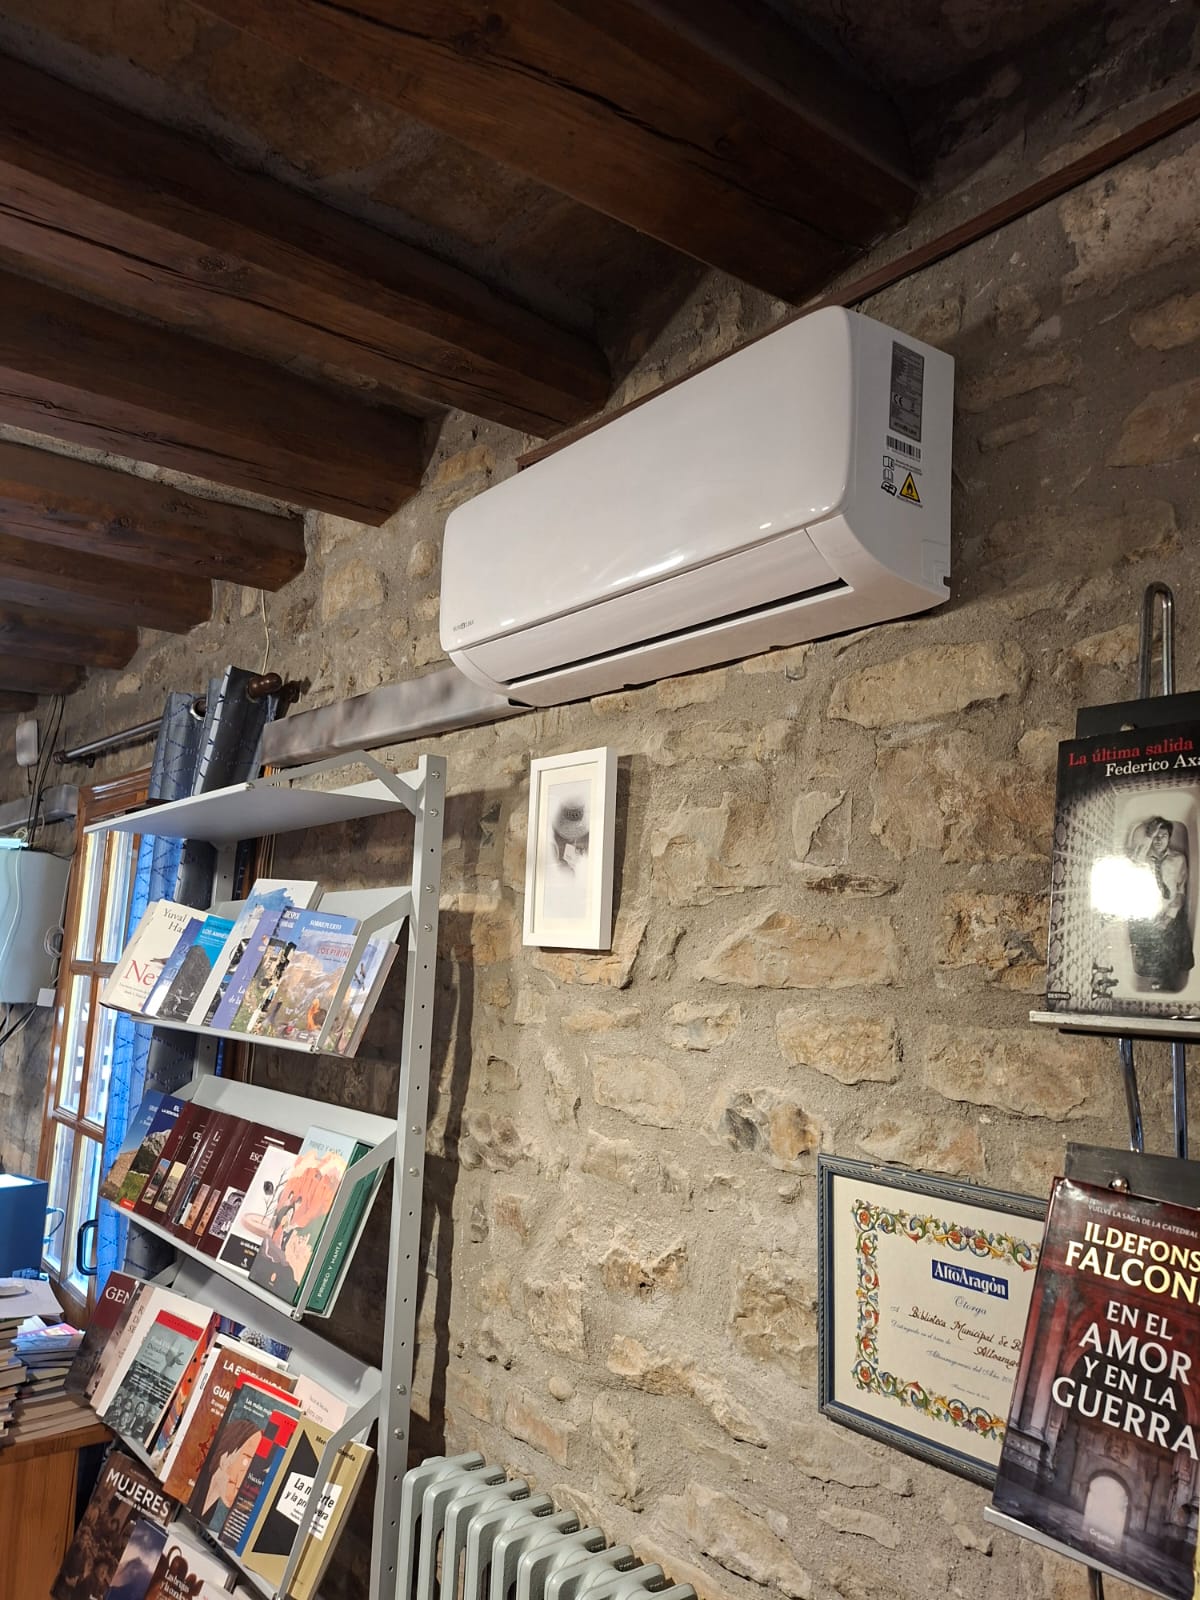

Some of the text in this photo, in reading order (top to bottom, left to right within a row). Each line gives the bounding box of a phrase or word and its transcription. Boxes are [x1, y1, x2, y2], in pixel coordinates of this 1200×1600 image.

[1068, 737, 1193, 767] La última salida
[1105, 758, 1169, 777] Federico
[163, 908, 187, 923] Yuval
[168, 921, 185, 934] Ha
[123, 960, 158, 986] Ne
[1088, 1205, 1112, 1216] VUELVE
[1122, 1213, 1140, 1223] SAGA
[1141, 1218, 1151, 1226] DE
[1152, 1220, 1161, 1228] LA
[1162, 1223, 1198, 1239] CATEDRAL
[1084, 1221, 1200, 1272] ILDEFONS
[934, 1261, 1006, 1296] AltoAragón
[1065, 1240, 1200, 1306] FALCON
[908, 1305, 947, 1328] Biblioteca
[950, 1320, 995, 1343] Municipal
[1106, 1300, 1173, 1341] EN EL
[223, 1360, 234, 1373] LA
[1078, 1322, 1192, 1385] AMOR
[213, 1385, 232, 1401] GUA
[1084, 1355, 1177, 1411] Y EN LA
[1052, 1376, 1200, 1461] GUERRA
[106, 1467, 171, 1518] MUJERES
[294, 1478, 304, 1491] La
[285, 1490, 291, 1499] y
[291, 1492, 298, 1502] la
[297, 1498, 329, 1520] priera
